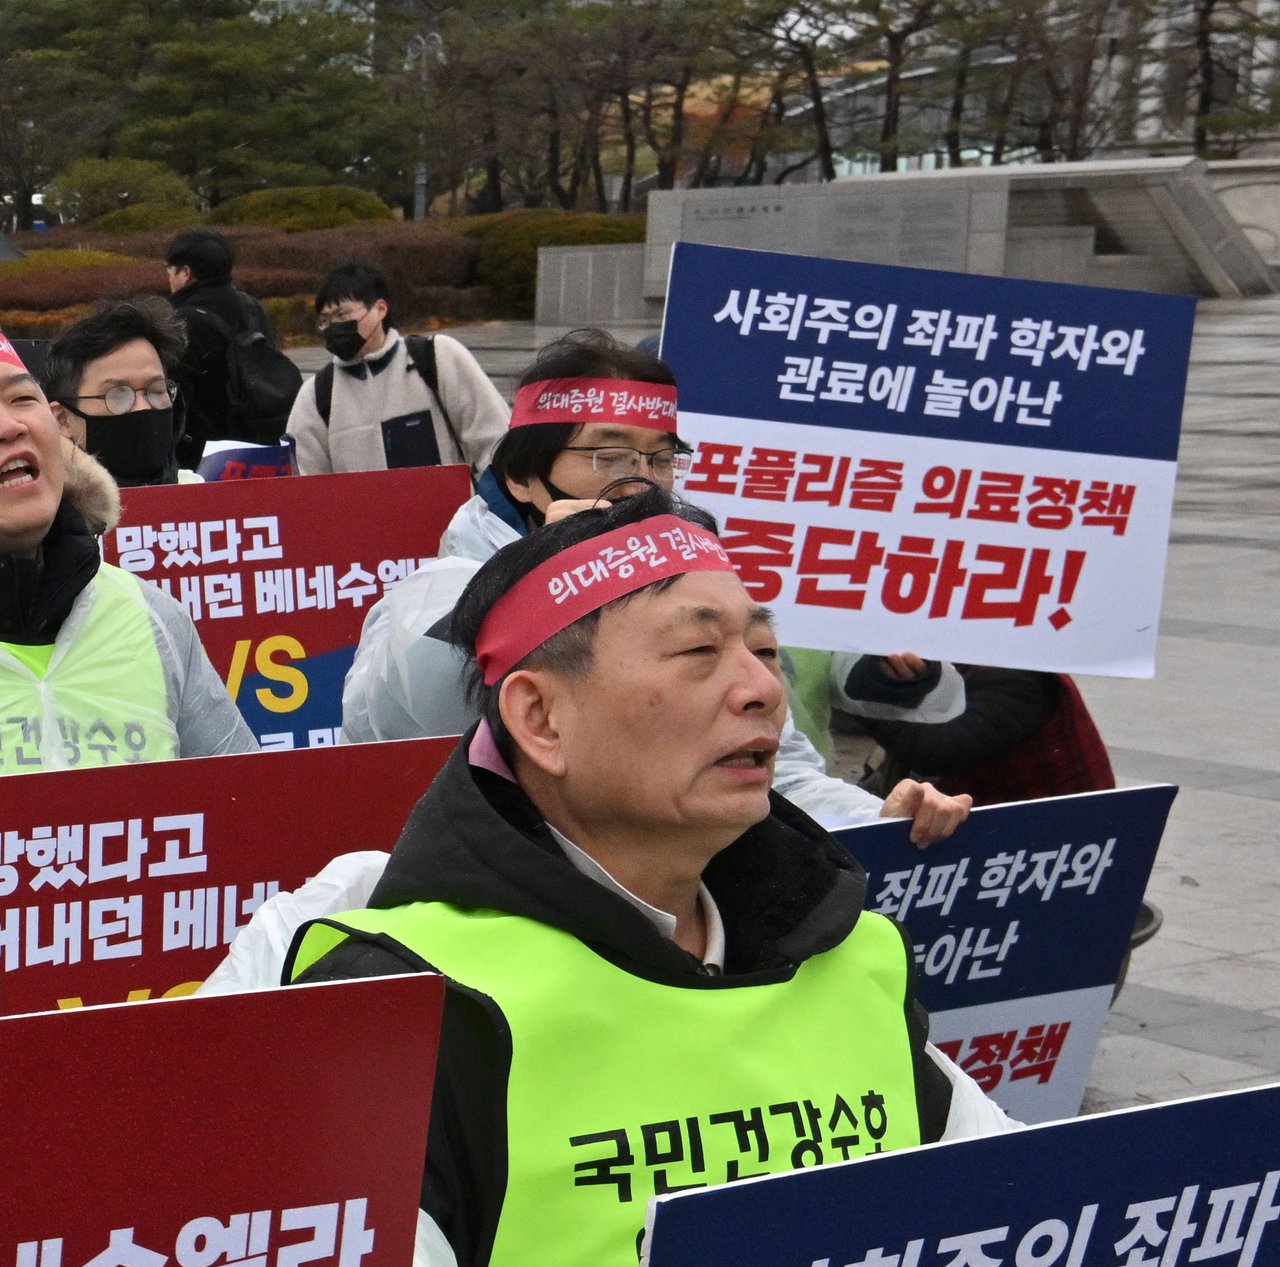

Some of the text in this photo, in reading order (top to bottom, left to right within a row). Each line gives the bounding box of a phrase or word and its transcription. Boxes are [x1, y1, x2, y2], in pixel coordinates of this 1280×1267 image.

[713, 286, 1146, 378] 사회주의 좌파 학자와
[538, 388, 606, 414] 의대증원
[776, 353, 1063, 429] 관료에 놀아난
[682, 440, 1138, 538] 포퓰리즘 의료정책
[114, 514, 284, 573] 망했다고
[547, 535, 666, 604] 의대증원
[720, 514, 1088, 634] 중단하라!
[874, 836, 1118, 923] 좌파 학자와
[913, 920, 1020, 986] 아난
[568, 1089, 891, 1204] 국민건강수호
